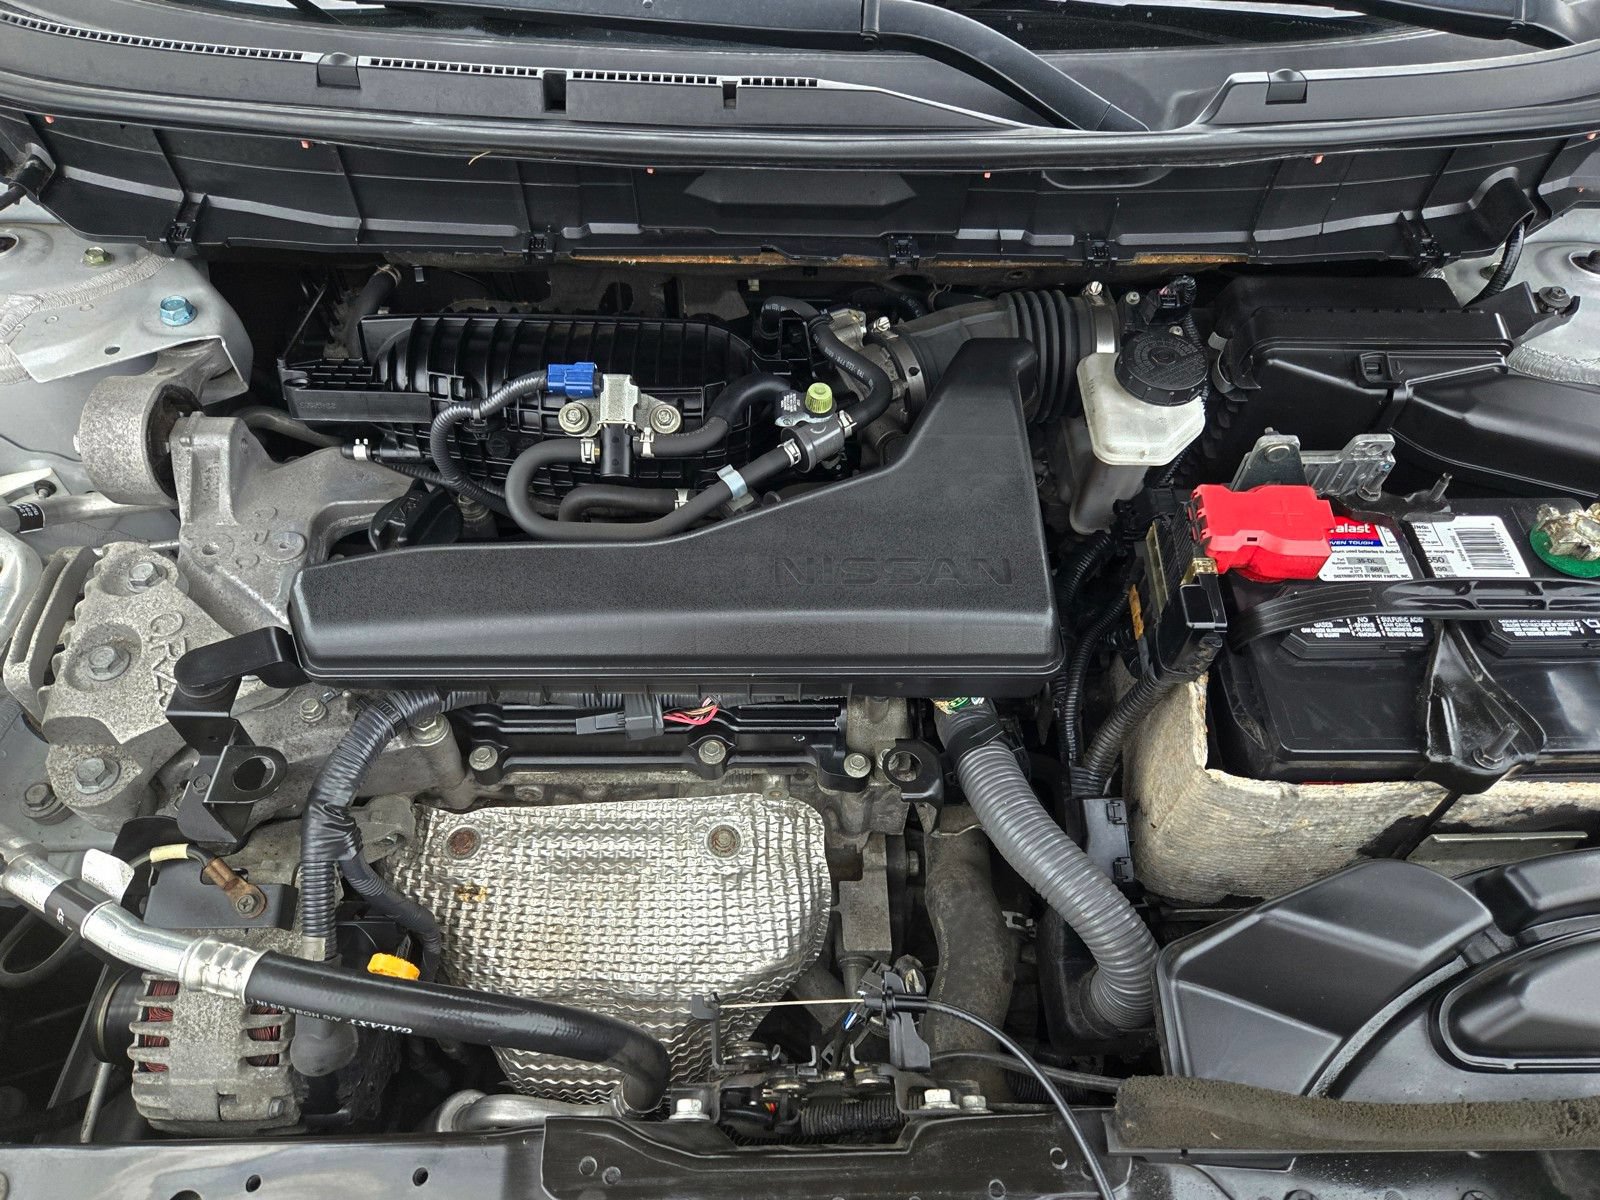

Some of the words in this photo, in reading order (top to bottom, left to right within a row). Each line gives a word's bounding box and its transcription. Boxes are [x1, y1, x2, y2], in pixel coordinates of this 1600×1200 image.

[1330, 523, 1371, 533] alast
[774, 557, 1013, 586] NISSAN
[288, 1007, 320, 1018] HOSE
[347, 1018, 413, 1035] GALAXY
